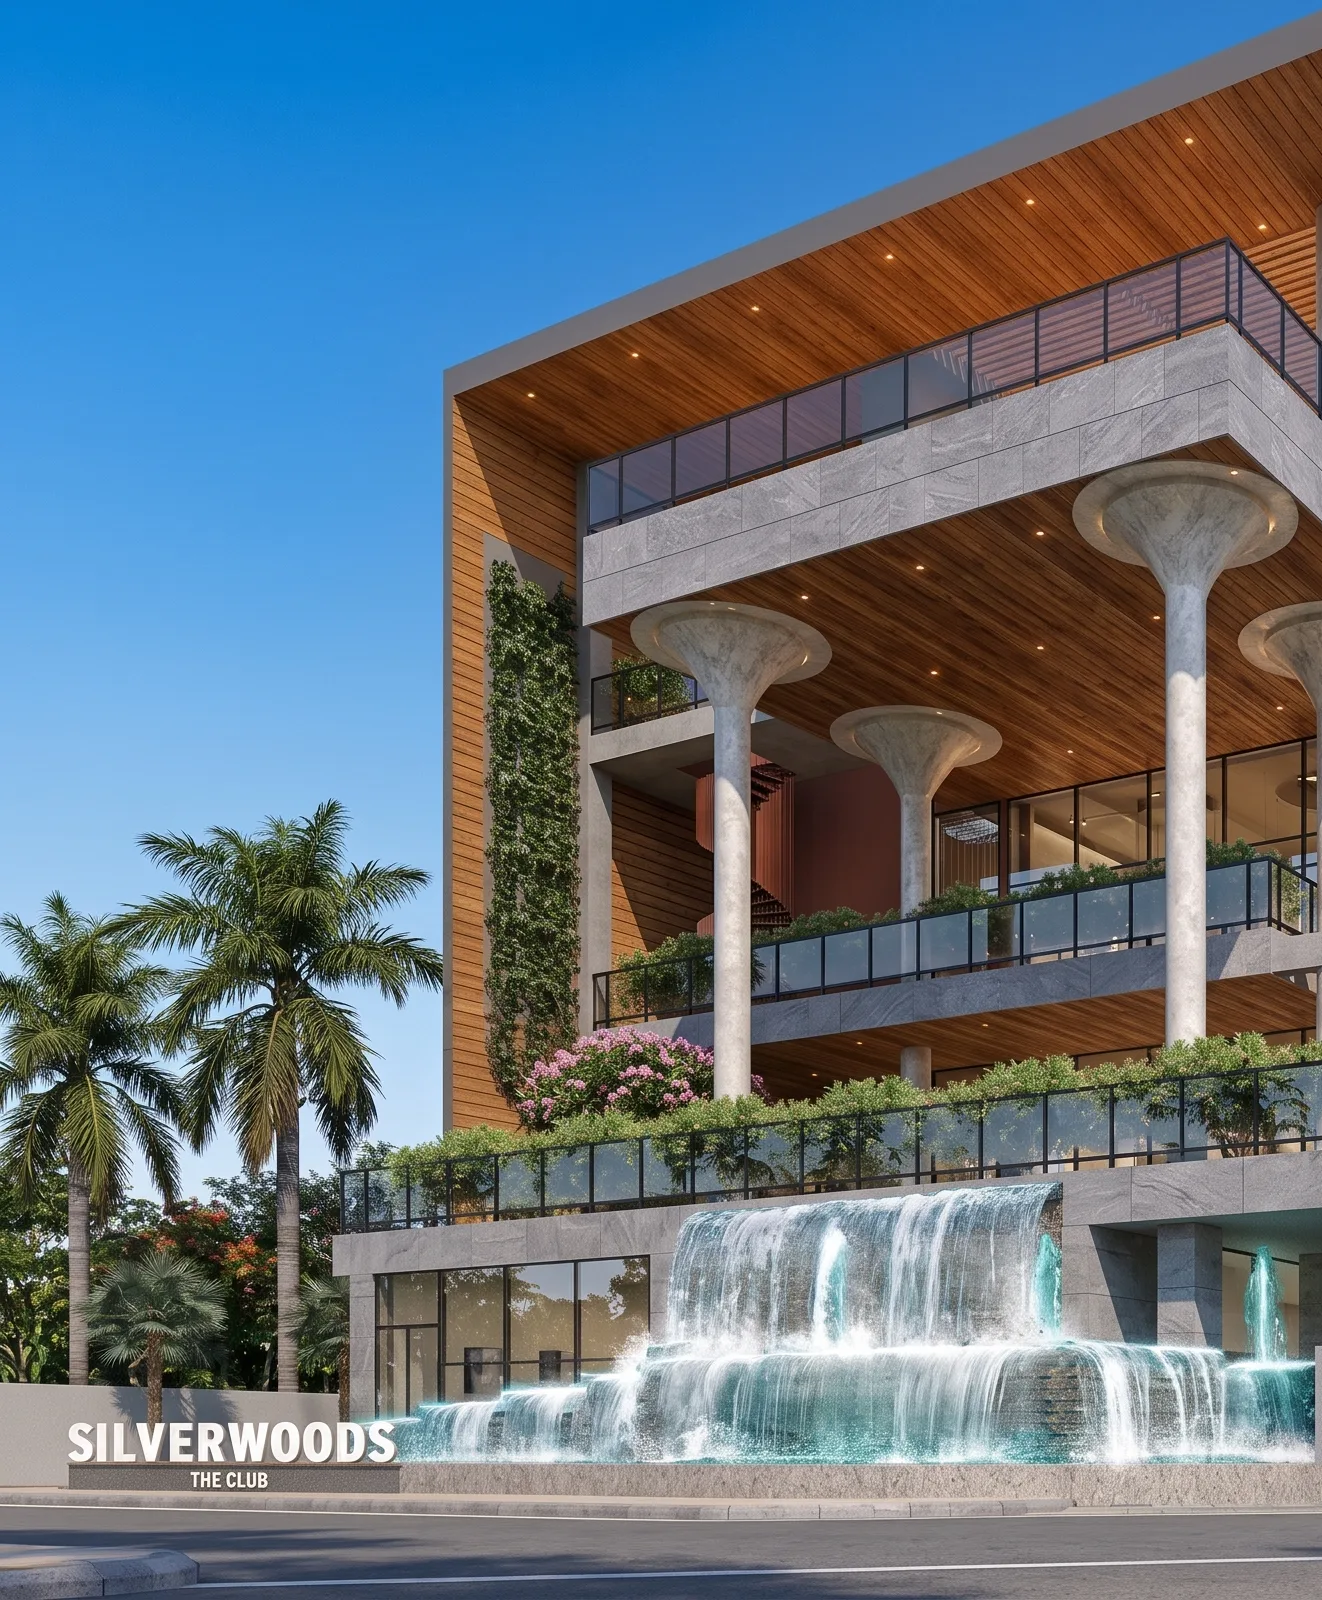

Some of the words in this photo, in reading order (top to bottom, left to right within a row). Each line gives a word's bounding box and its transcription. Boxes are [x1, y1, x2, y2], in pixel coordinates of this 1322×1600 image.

[67, 1421, 397, 1463] SILVERWOODS
[190, 1471, 222, 1488] THE
[226, 1471, 268, 1489] CLUB
